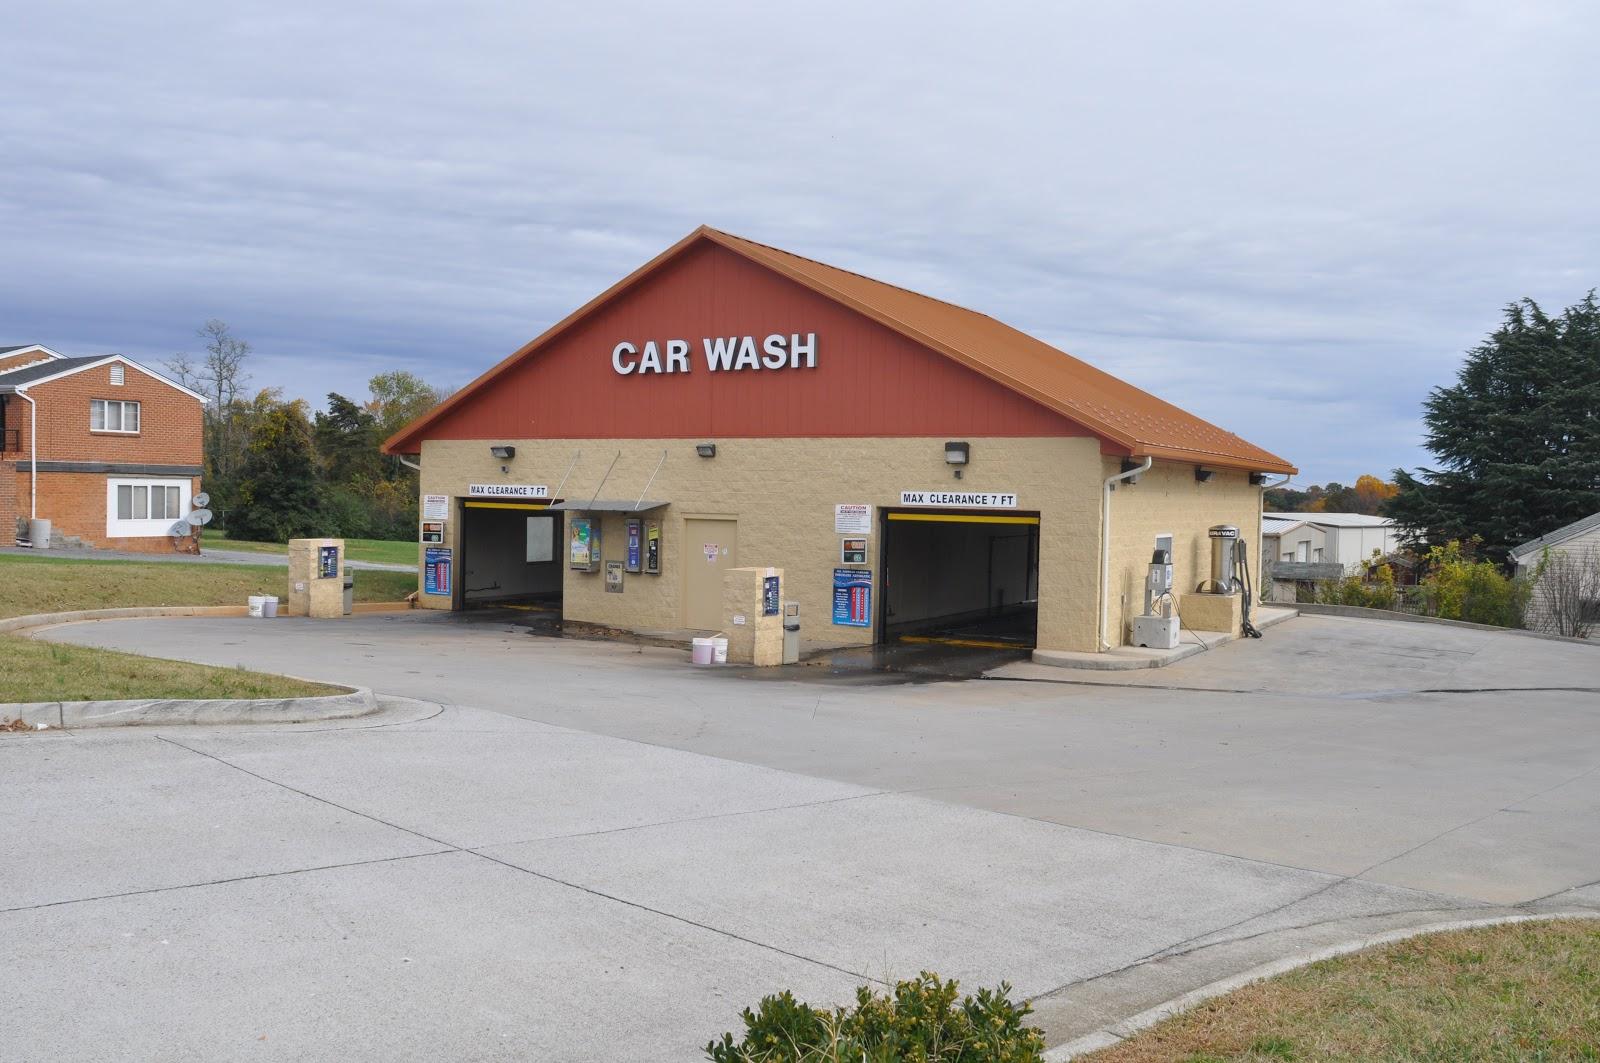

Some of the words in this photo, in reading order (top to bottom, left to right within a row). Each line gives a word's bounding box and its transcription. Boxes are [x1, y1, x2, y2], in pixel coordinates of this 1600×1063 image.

[611, 339, 690, 375] CAR
[703, 332, 817, 372] WASH
[471, 485, 485, 494] MAX
[487, 486, 527, 495] CLEARANCE
[530, 487, 534, 495] 7
[536, 487, 546, 495] FT
[903, 493, 924, 503] MAX
[929, 493, 988, 505] CLEARANCE
[991, 495, 997, 505] 7
[1001, 495, 1014, 505] FT
